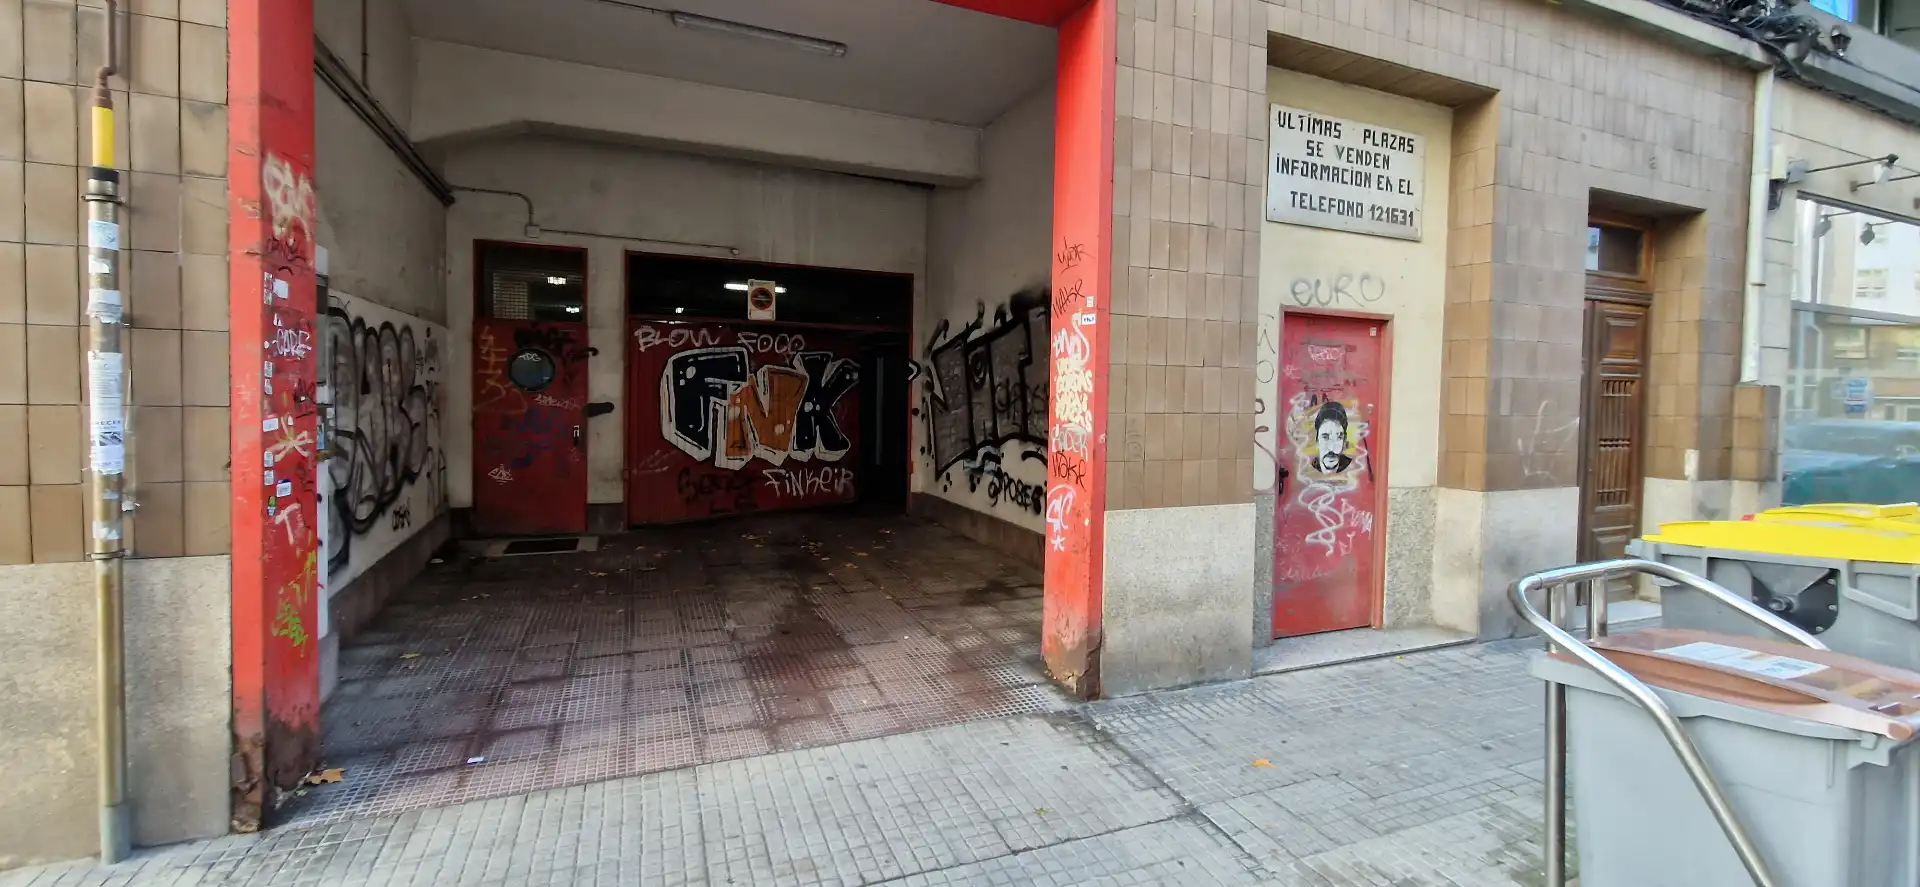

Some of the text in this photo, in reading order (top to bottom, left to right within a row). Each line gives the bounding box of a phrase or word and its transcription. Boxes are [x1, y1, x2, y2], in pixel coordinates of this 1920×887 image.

[1277, 110, 1415, 154] ULTIMAS PLAZAS
[1276, 152, 1414, 196] INFORMACION EN EL
[1306, 140, 1390, 170] SE VENDEN
[1290, 190, 1414, 227] TELEFONO 121631
